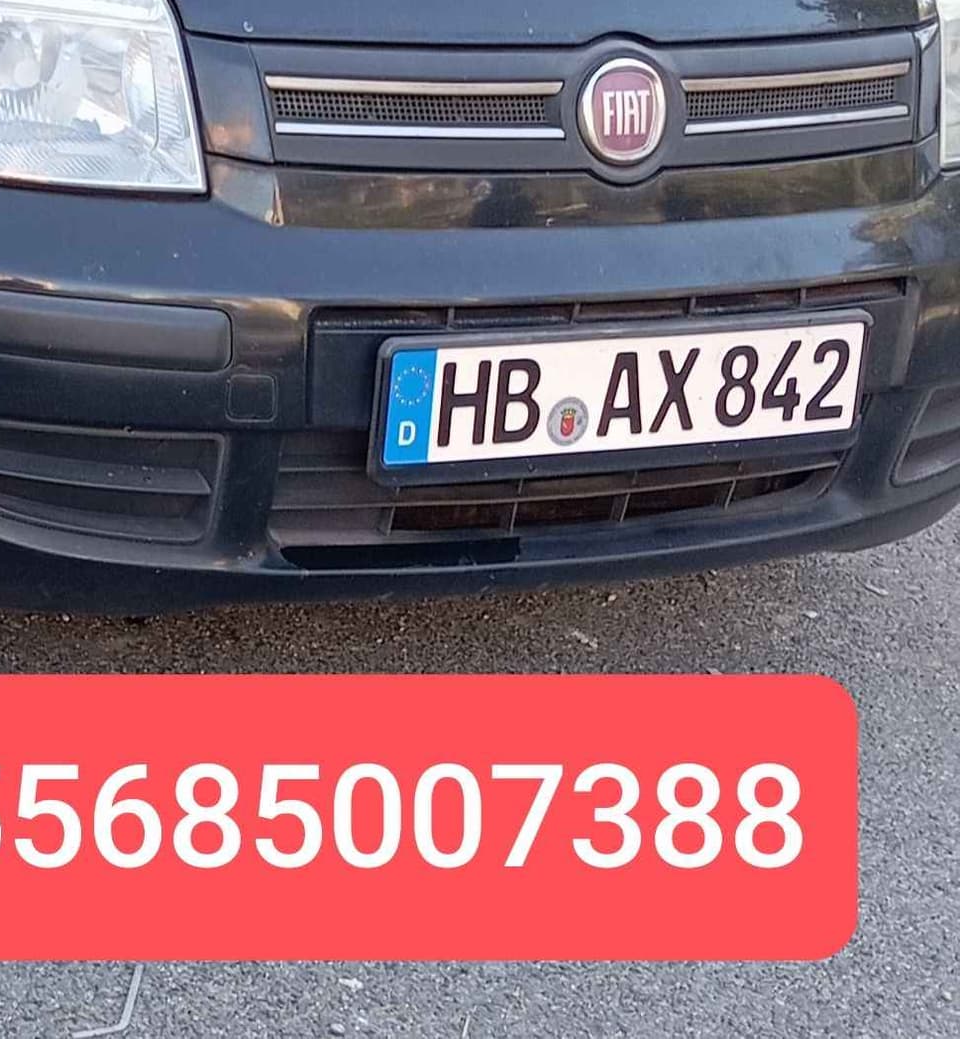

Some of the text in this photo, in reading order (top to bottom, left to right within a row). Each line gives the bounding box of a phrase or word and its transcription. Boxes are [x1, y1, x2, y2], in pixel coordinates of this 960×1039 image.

[602, 89, 650, 137] FIAT
[397, 338, 851, 448] D HB AX 842
